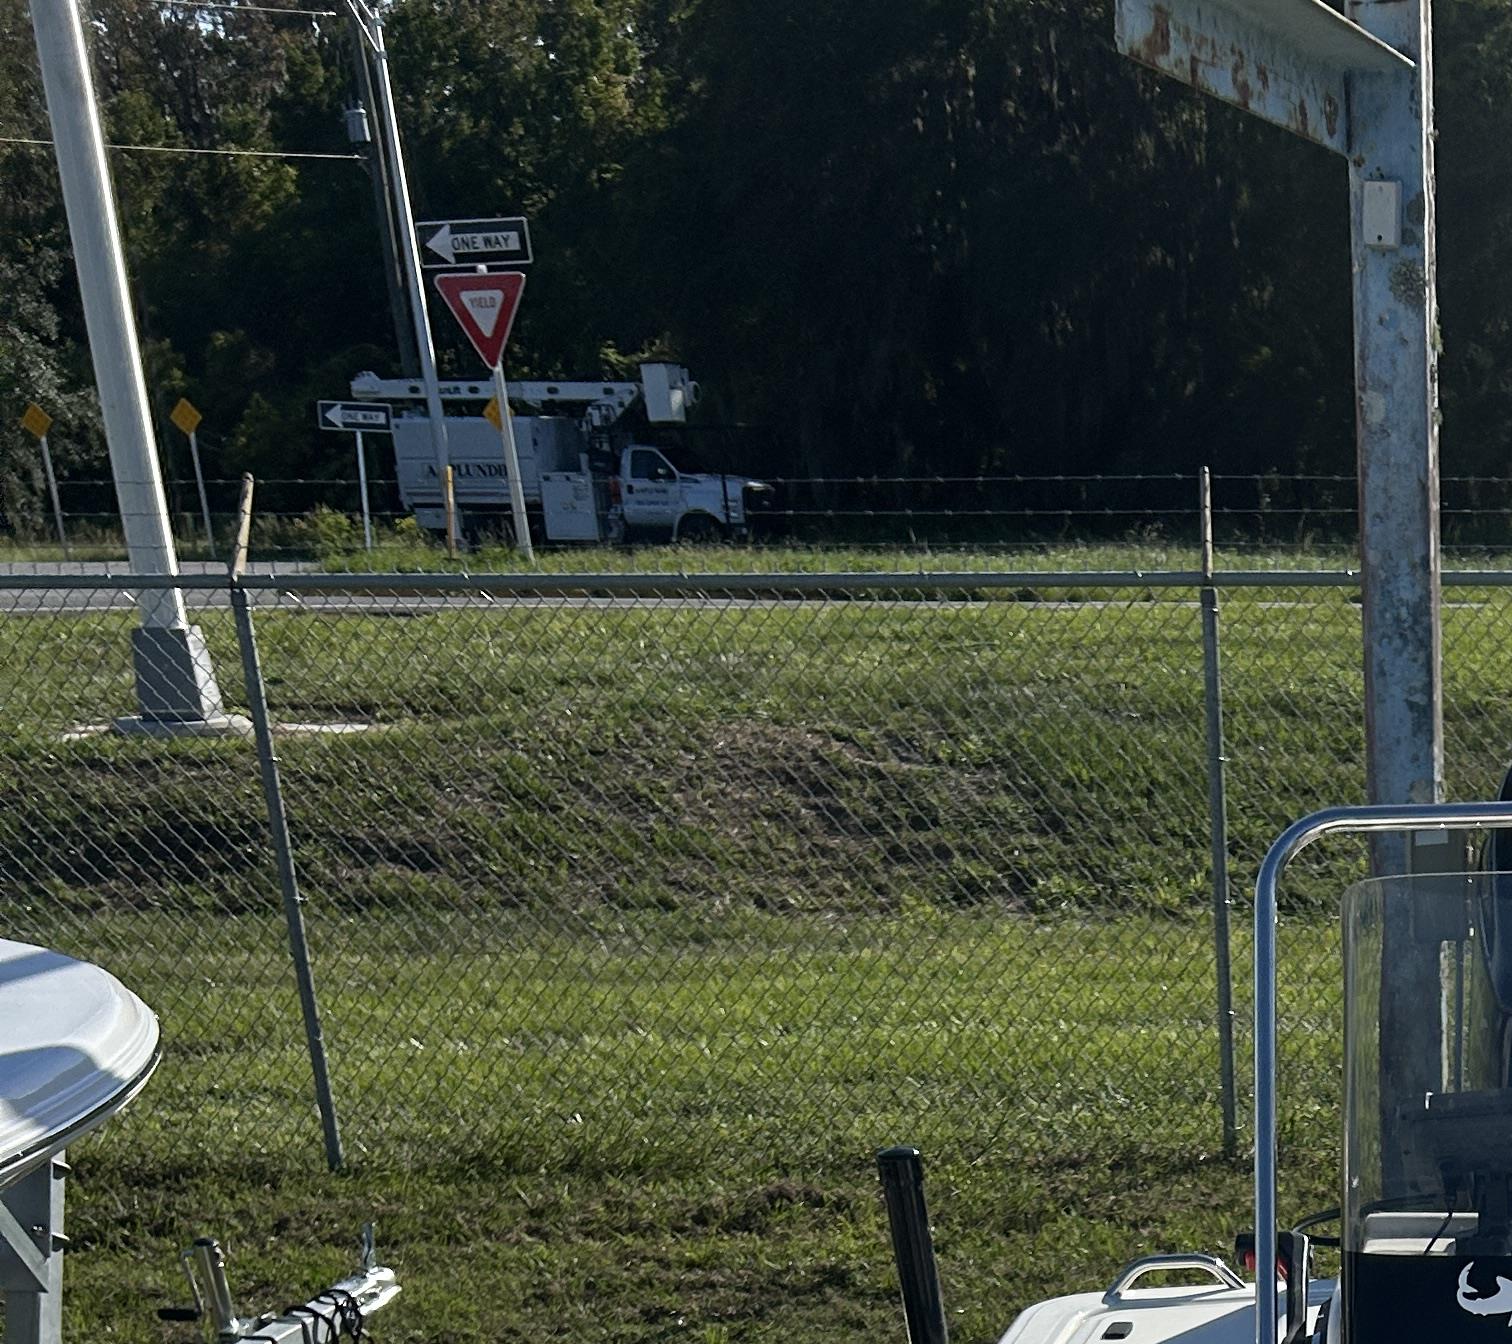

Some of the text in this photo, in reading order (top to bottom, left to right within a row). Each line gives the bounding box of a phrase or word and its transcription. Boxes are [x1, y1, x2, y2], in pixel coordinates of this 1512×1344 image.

[451, 235, 512, 251] ONE WAY
[468, 297, 496, 309] YIELD
[341, 411, 380, 421] ONE WAY
